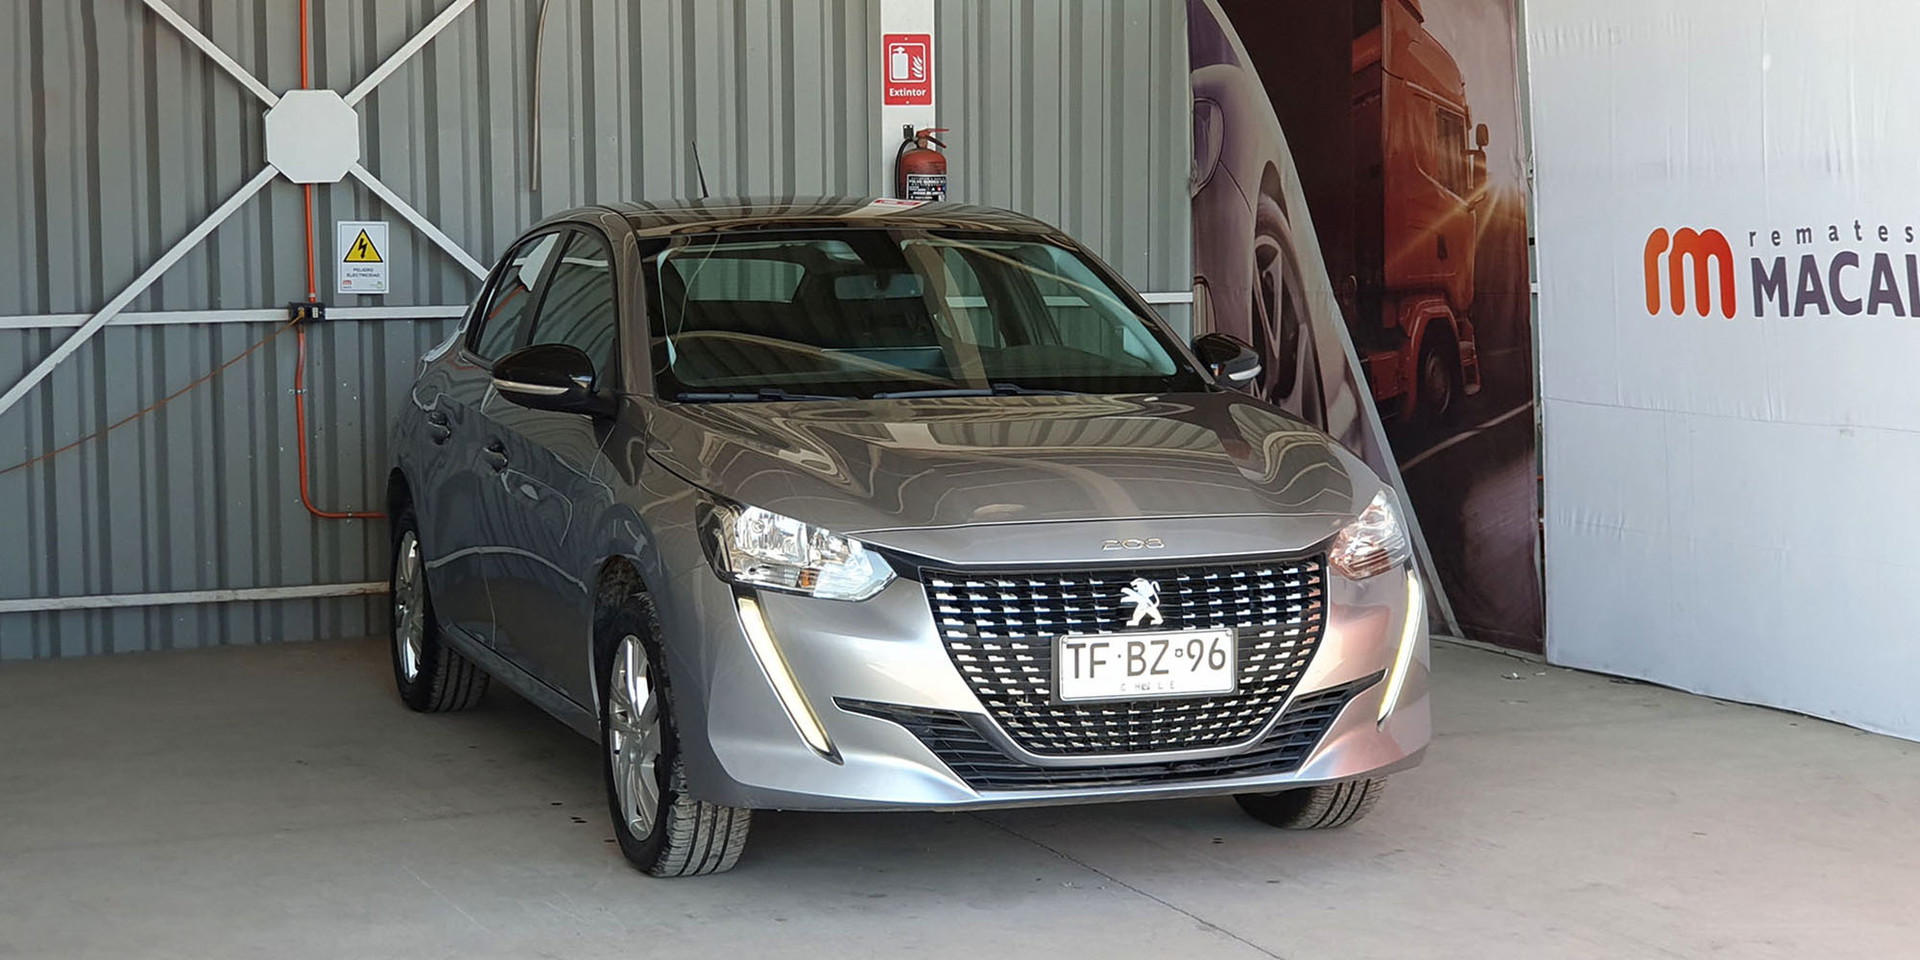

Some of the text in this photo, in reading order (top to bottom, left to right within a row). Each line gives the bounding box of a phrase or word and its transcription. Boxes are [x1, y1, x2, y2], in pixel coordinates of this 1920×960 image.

[889, 88, 926, 97] Extintor
[1749, 220, 1914, 247] remates
[1101, 538, 1165, 551] 208
